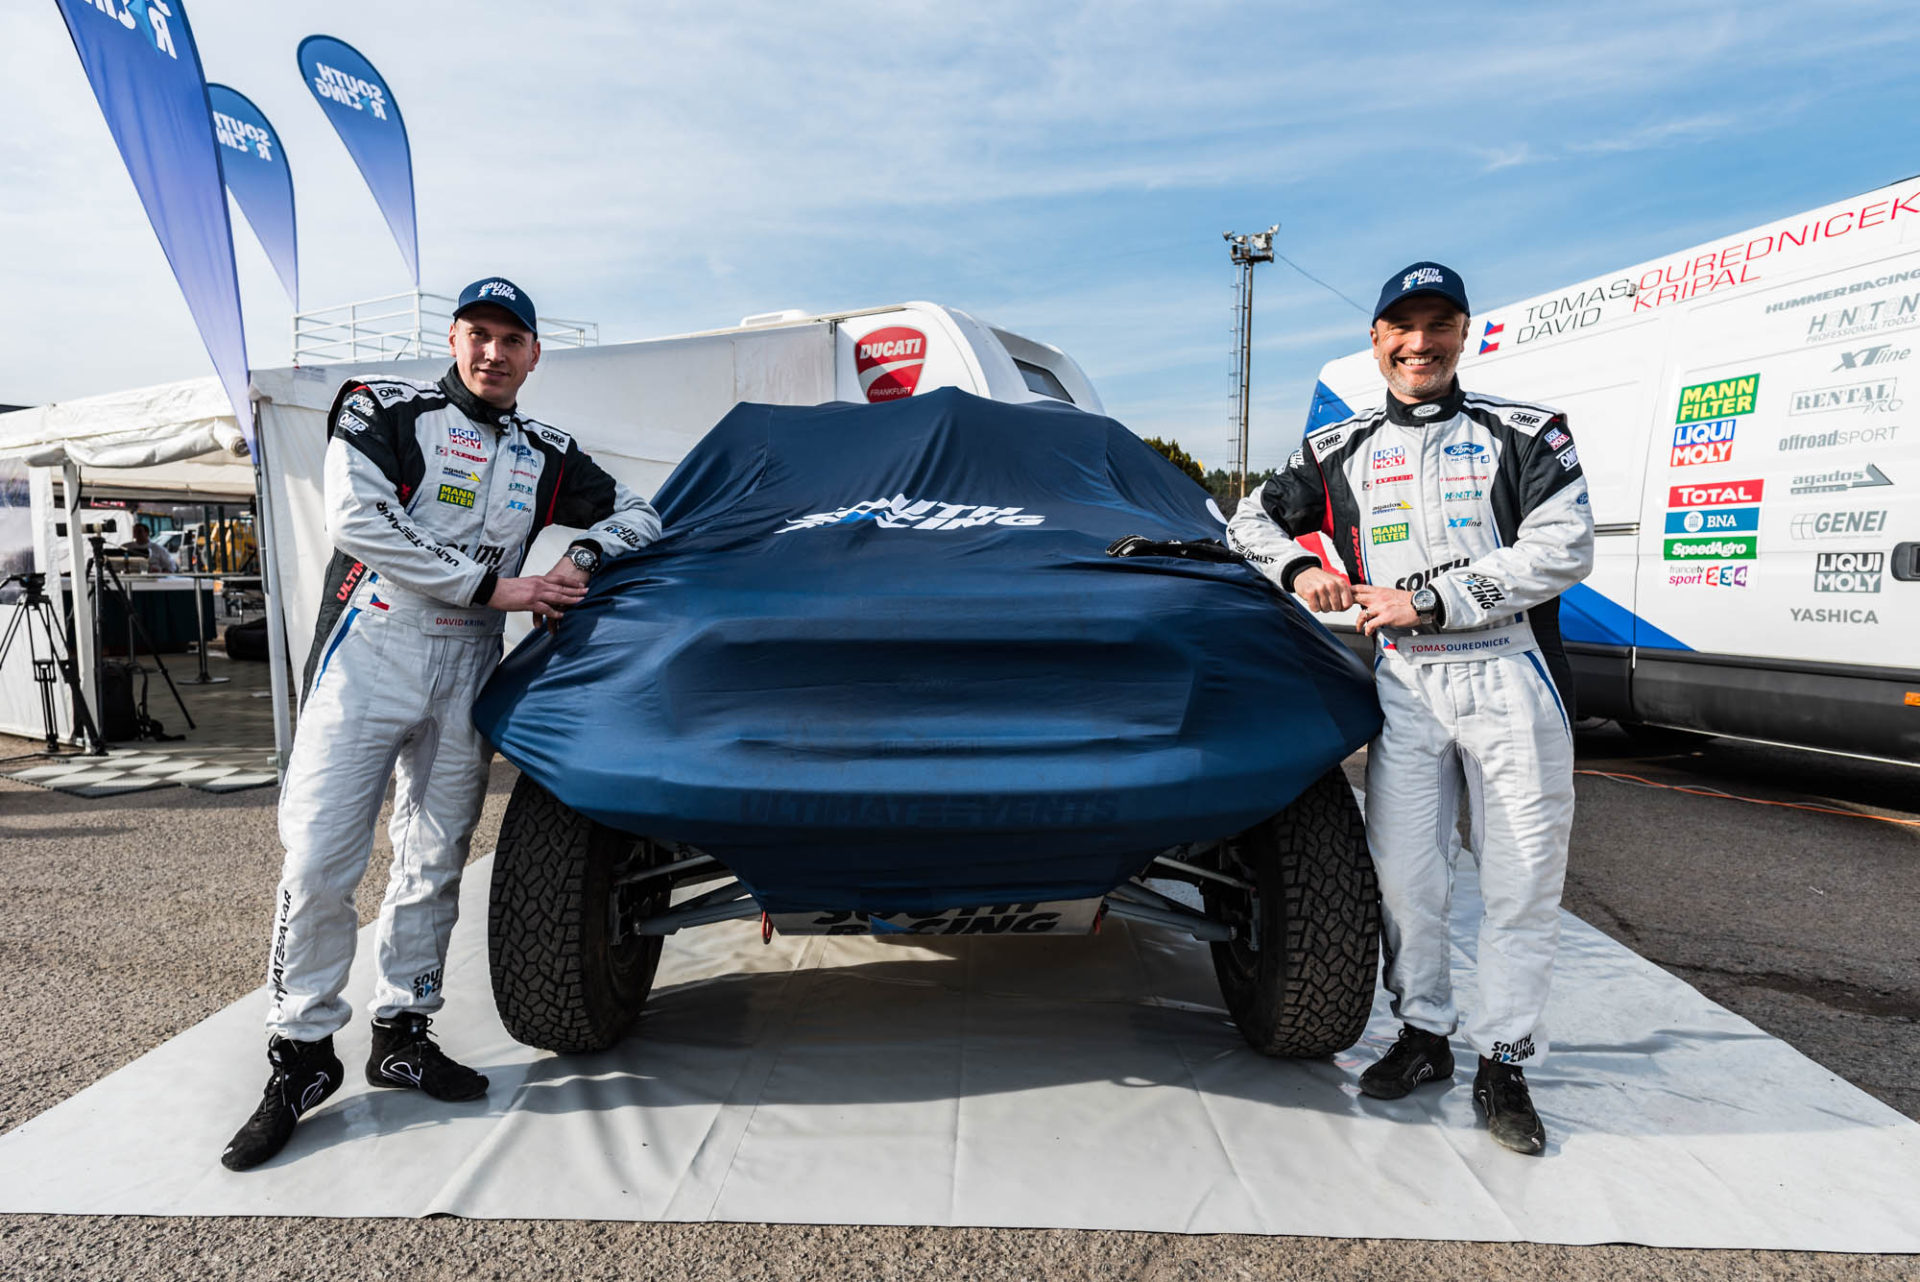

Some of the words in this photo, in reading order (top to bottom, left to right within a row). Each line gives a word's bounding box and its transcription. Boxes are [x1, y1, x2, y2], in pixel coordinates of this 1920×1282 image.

[1526, 278, 1630, 324] TOMAS
[1639, 191, 1920, 291] OUREDNICEK
[1516, 306, 1602, 345] DAVID
[1633, 263, 1762, 313] KRIPAL
[1806, 322, 1878, 343] PROFESSIONAL
[1881, 313, 1917, 328] TOOLS
[860, 338, 922, 359] DUCATI
[870, 386, 913, 397] FRANKFURT
[1682, 377, 1756, 405] MANN
[1796, 384, 1891, 411] RENTAL
[1680, 395, 1753, 422] FILTER
[1863, 398, 1904, 415] PRO
[340, 413, 367, 432] OMP
[1510, 413, 1540, 426] OMP
[450, 428, 480, 441] LIQUI
[541, 431, 566, 444] OMP
[1316, 432, 1342, 451] OMP
[1675, 420, 1735, 446] LIQUI
[450, 436, 481, 450] MOLY
[1450, 444, 1477, 455] Ford
[1374, 446, 1406, 461] LIQUI
[1672, 441, 1733, 467] MOLY
[1373, 456, 1406, 469] MOLY
[1792, 470, 1865, 486] agados
[440, 493, 474, 508] FILTER
[441, 485, 475, 500] MANN
[1707, 515, 1737, 528] BNA
[1815, 510, 1888, 533] GENEI
[1372, 525, 1407, 536] MANN
[1373, 532, 1408, 544] FILTER
[1671, 542, 1747, 558] SpeedAgro
[1817, 553, 1881, 573] LIQUI
[1669, 573, 1702, 587] sport
[1815, 572, 1882, 593] MOLY
[1790, 607, 1879, 624] YASHICA
[1491, 1033, 1532, 1053] SOUTH
